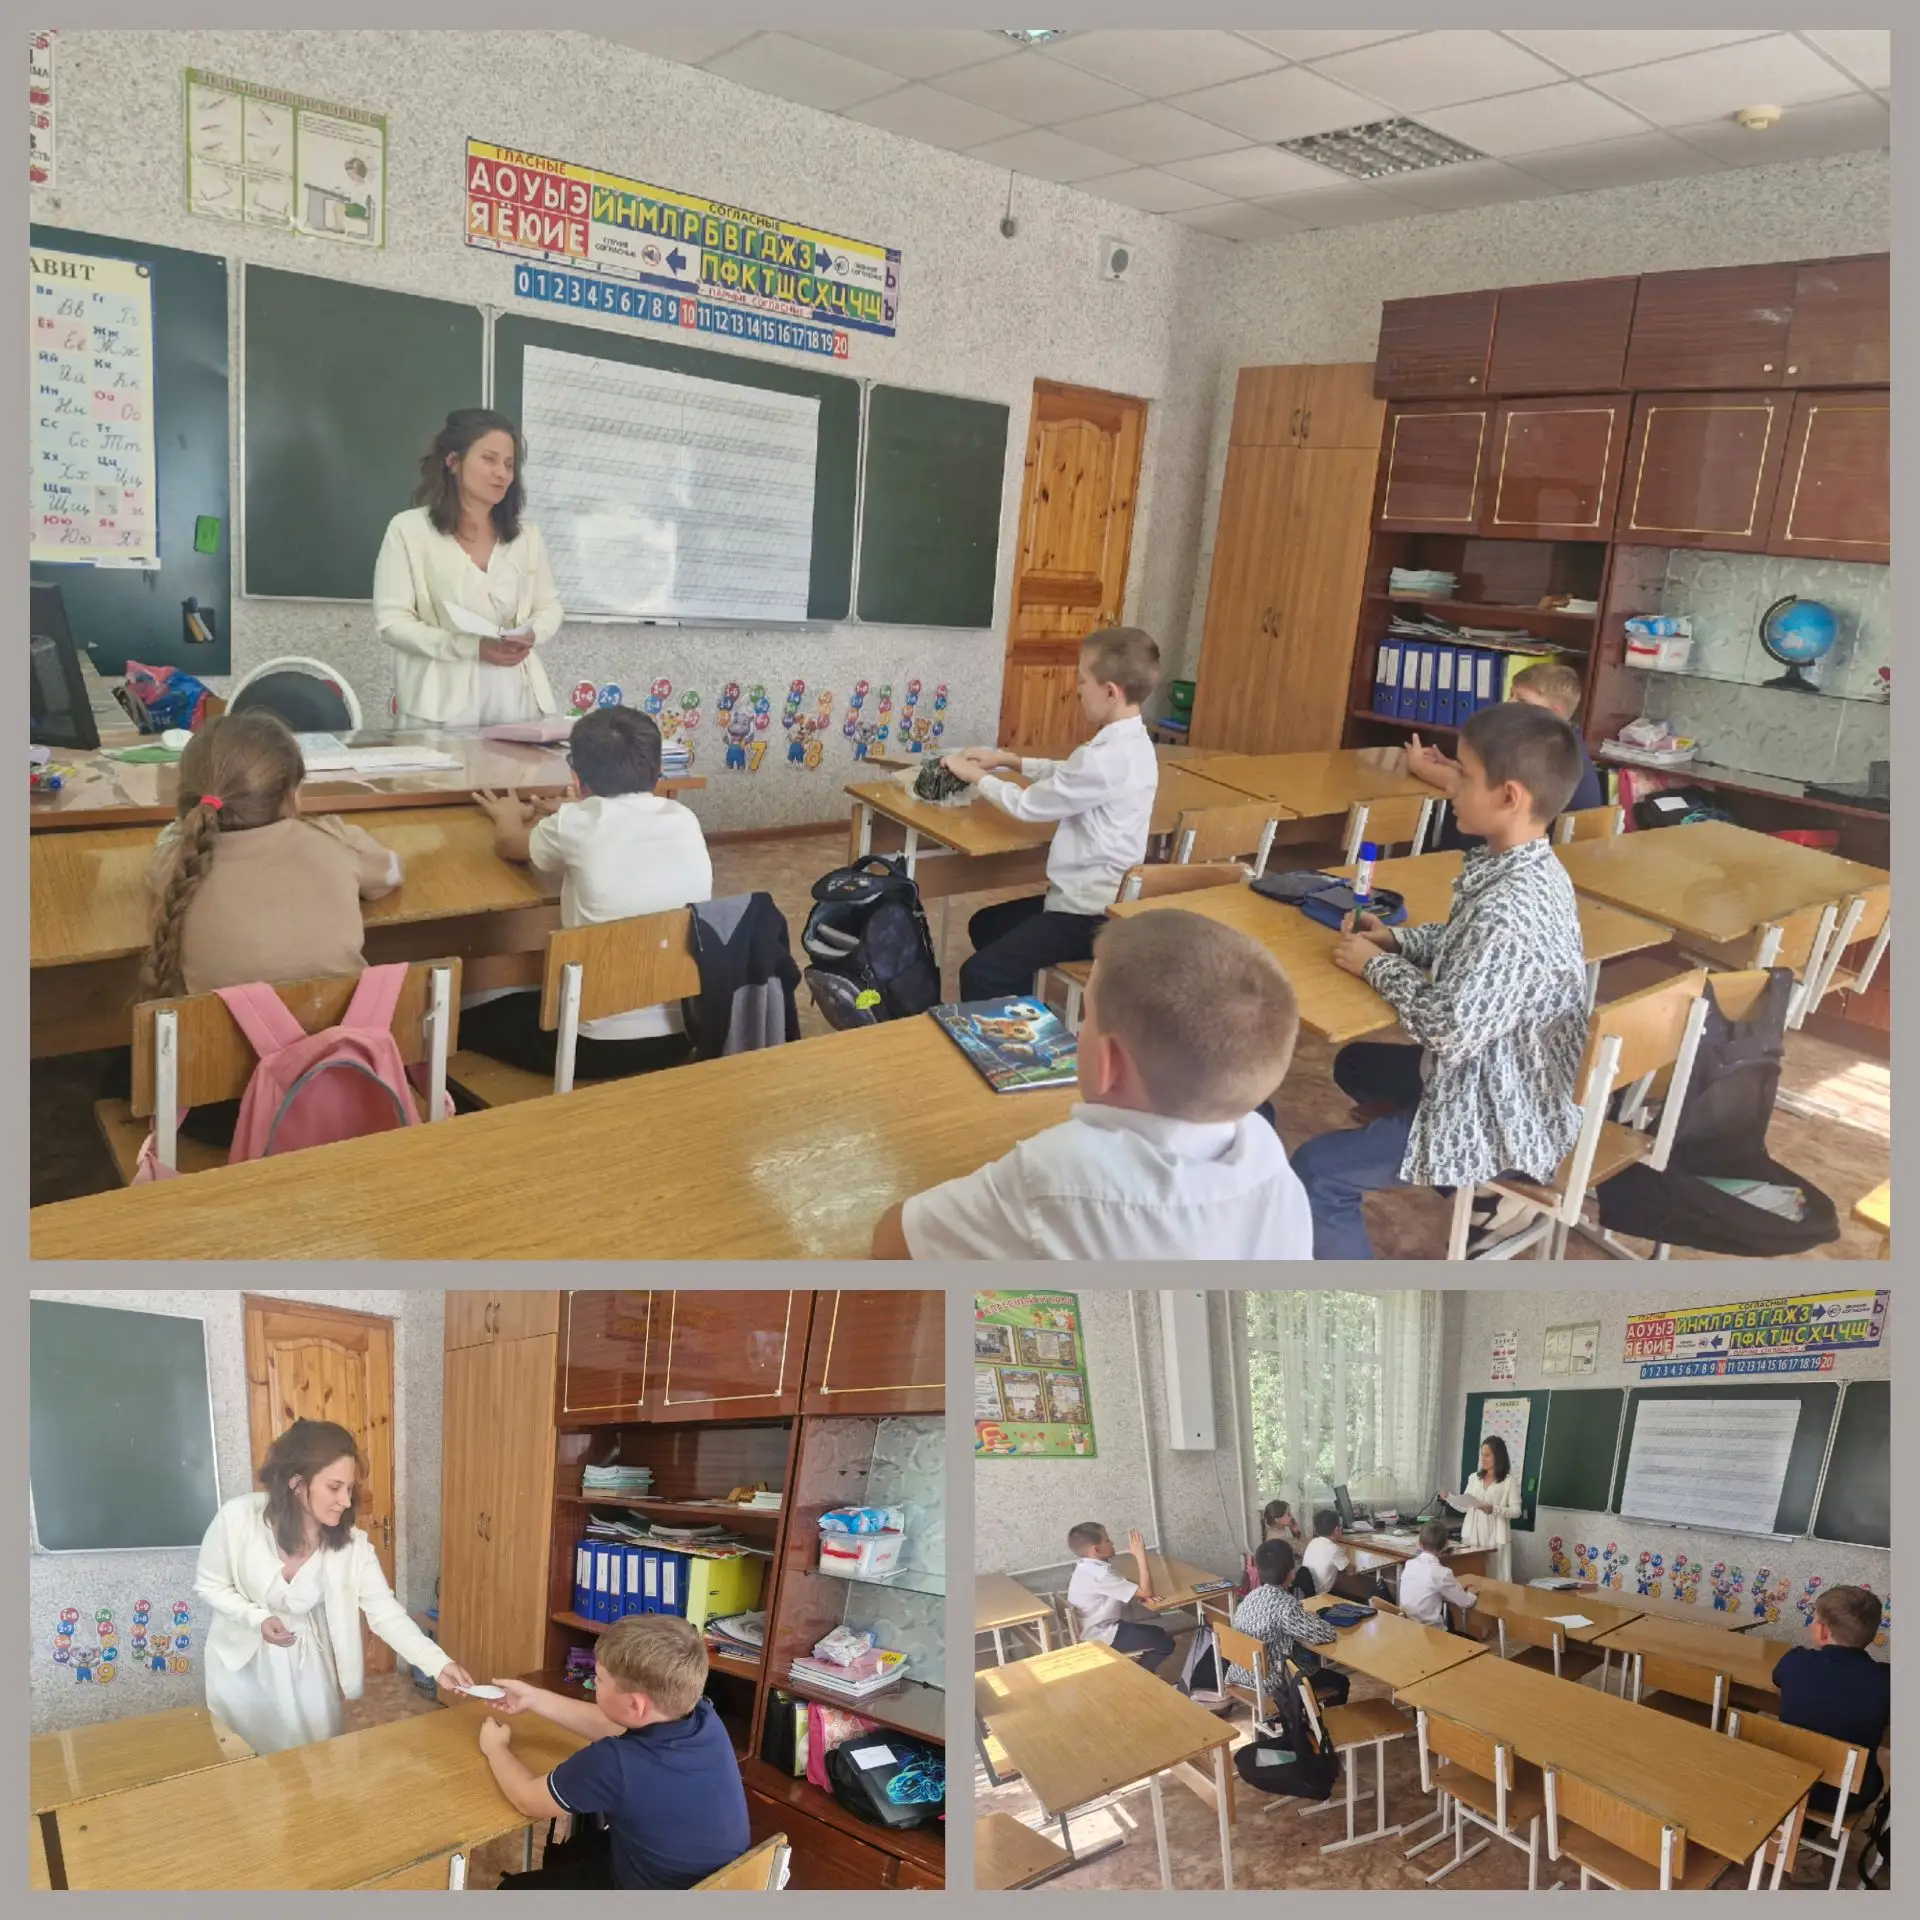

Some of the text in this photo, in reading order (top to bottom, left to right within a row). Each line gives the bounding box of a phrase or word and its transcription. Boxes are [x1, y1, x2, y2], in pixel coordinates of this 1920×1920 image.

[496, 149, 565, 176] ГЛАСНЫЕ
[708, 204, 781, 231] СОГЛАСНЫЕ
[519, 272, 848, 355] 0 1 2 3 4 5 6 7 8 9 10 11 12 13 14 15 16 17 18 19 20
[751, 297, 805, 316] СОГЛАСНЫЕ
[94, 390, 115, 402] Оо
[121, 403, 141, 421] Оо
[40, 418, 59, 429] Сс
[68, 431, 89, 448] Сс
[43, 515, 72, 525] Юю
[574, 690, 593, 703] 1+4
[749, 741, 767, 772] 7
[805, 740, 823, 769] 8
[97, 1663, 116, 1684] 9
[168, 1656, 189, 1674] 10
